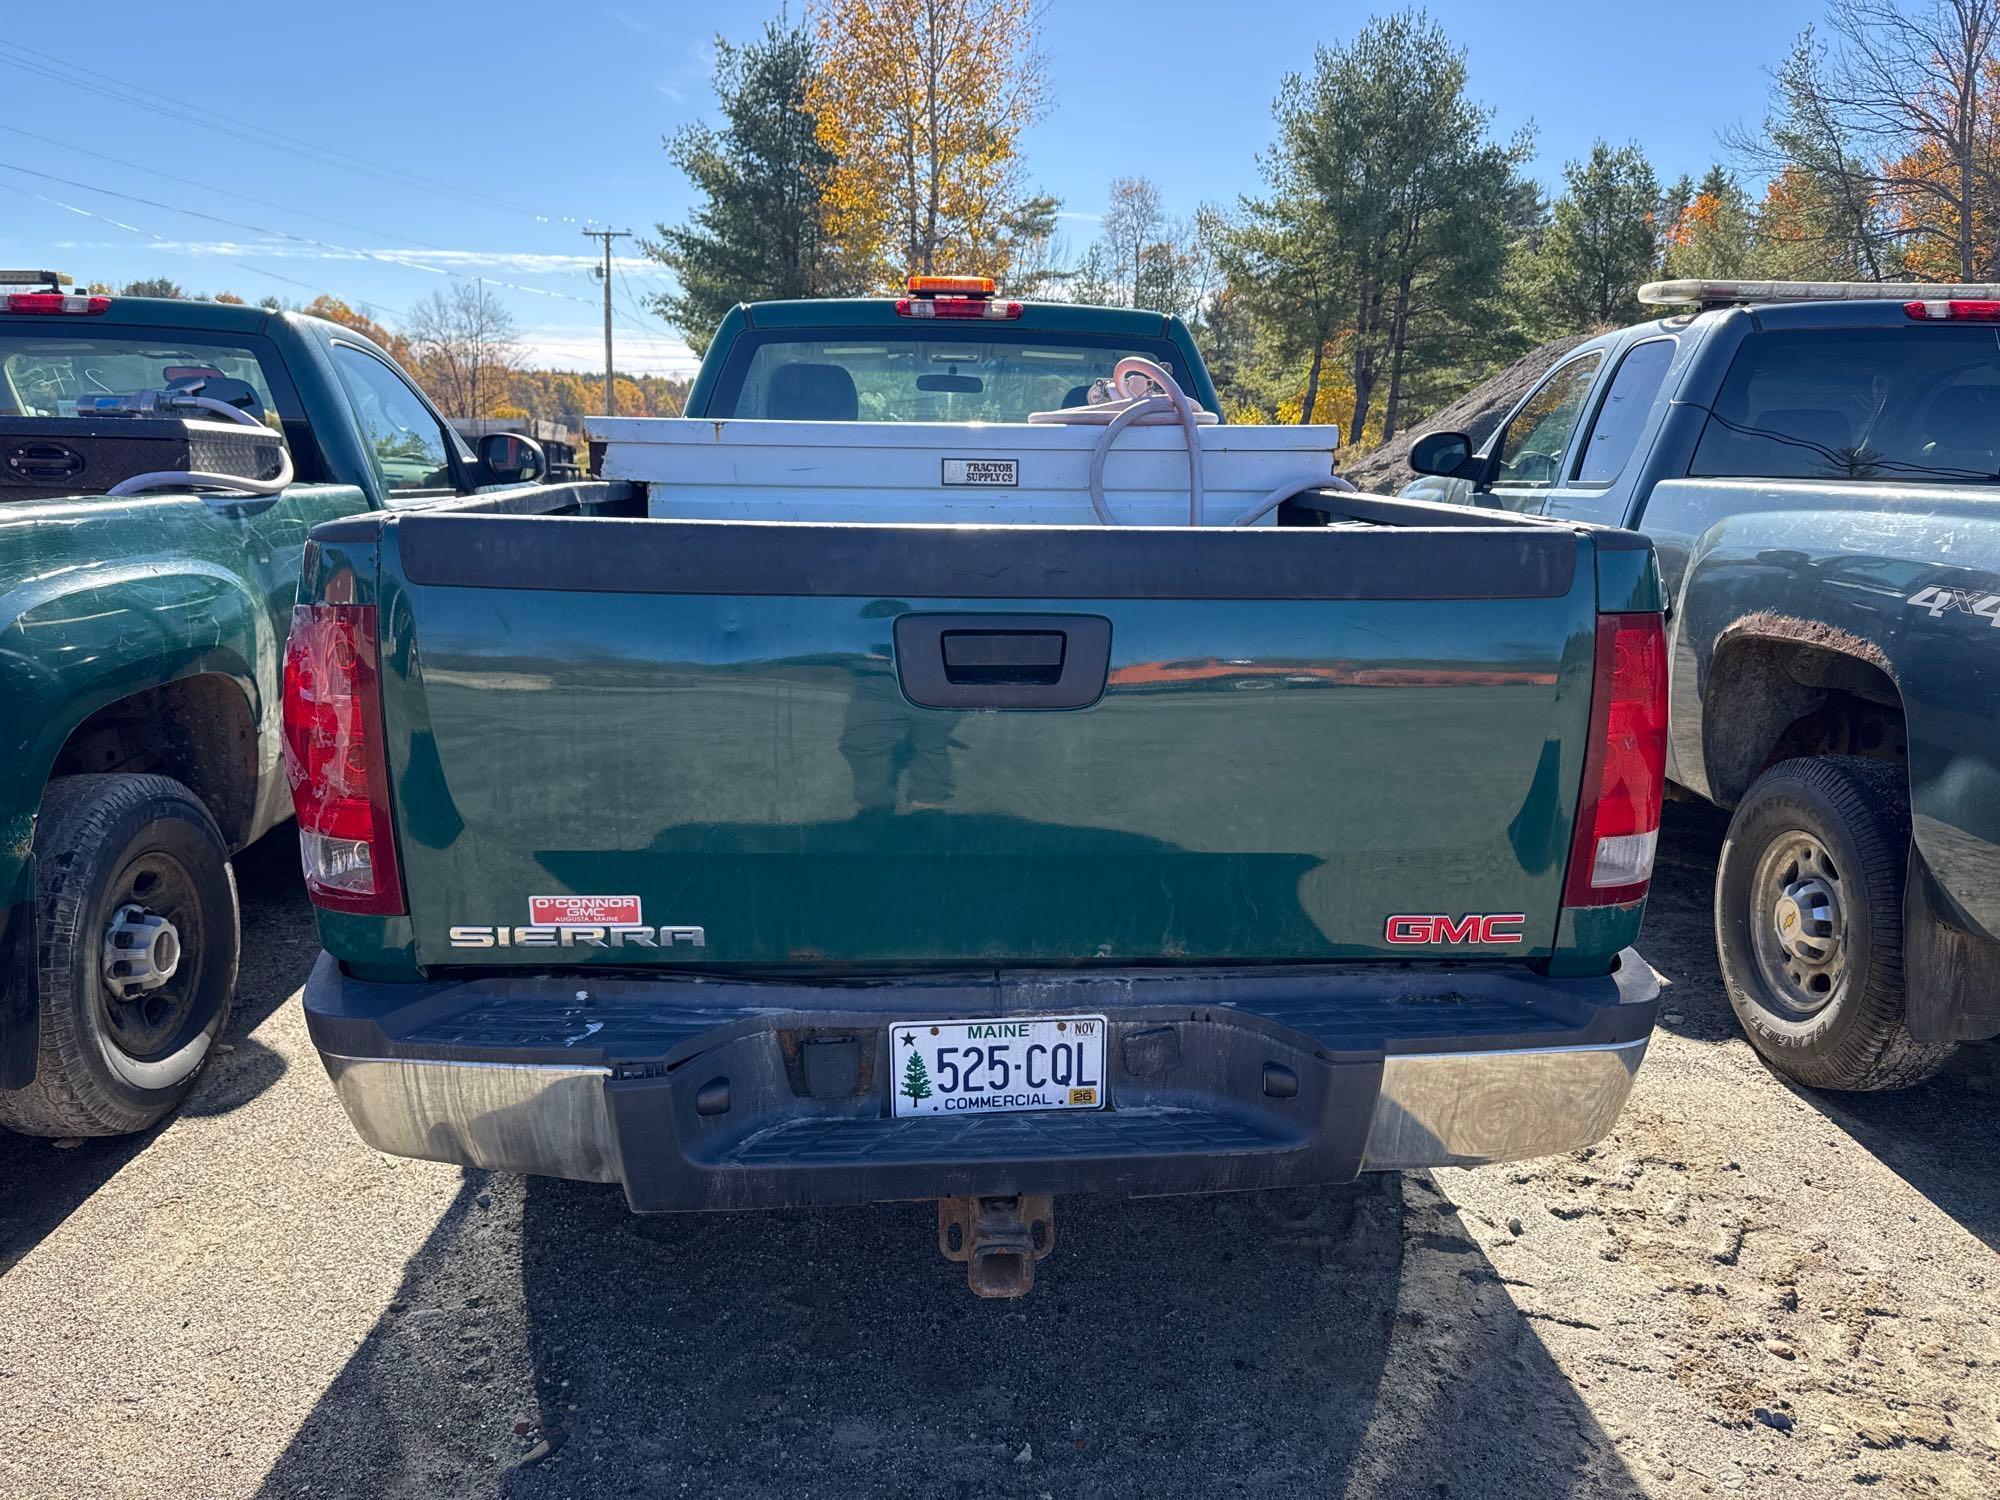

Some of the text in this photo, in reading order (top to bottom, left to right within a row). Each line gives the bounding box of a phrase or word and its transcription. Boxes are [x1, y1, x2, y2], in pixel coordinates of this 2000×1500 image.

[966, 463, 1013, 473] TRACTOR
[966, 473, 1001, 482] SUPPLY
[536, 899, 635, 908] O'CONNOR
[567, 908, 605, 917] GMC
[1386, 914, 1526, 944] GMC
[449, 926, 706, 949] SIERRA
[967, 1024, 1030, 1039] MAINE
[1075, 1022, 1095, 1034] NOV
[937, 1042, 1097, 1093] 525-CQL
[945, 1094, 1052, 1111] COMMERCIAL
[1073, 1093, 1092, 1101] 26
